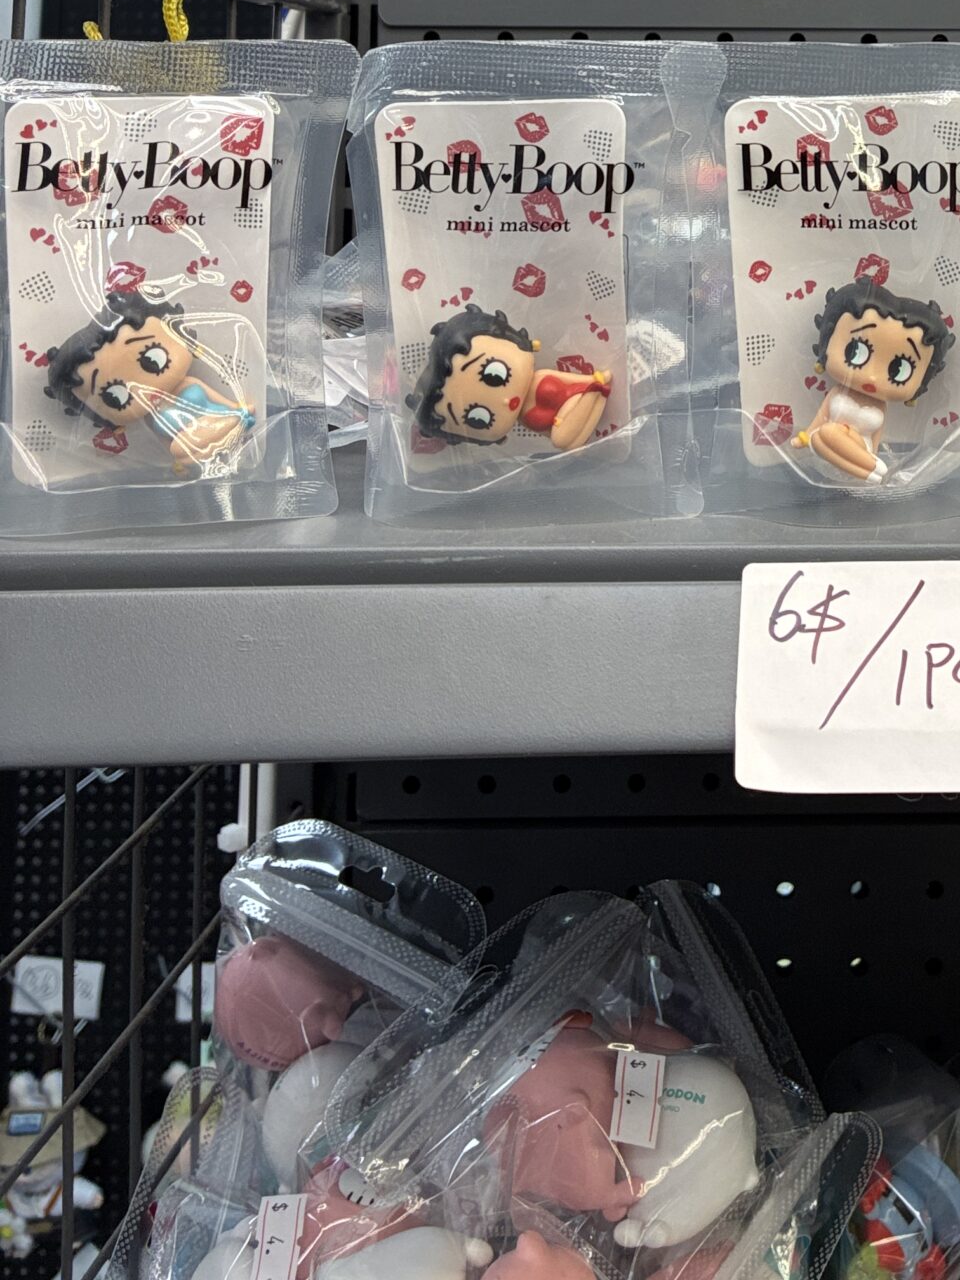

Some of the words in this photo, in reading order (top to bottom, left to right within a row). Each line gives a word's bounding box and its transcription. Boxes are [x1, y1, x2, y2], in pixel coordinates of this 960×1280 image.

[11, 141, 137, 209] Betty
[144, 140, 273, 211] Boop
[392, 140, 505, 212] Betty
[512, 144, 635, 213] Boop
[736, 142, 847, 209] Betty
[131, 211, 206, 228] mascot
[446, 219, 493, 233] mini
[500, 218, 571, 234] mascot
[800, 216, 846, 231] mini
[853, 216, 918, 232] mascot
